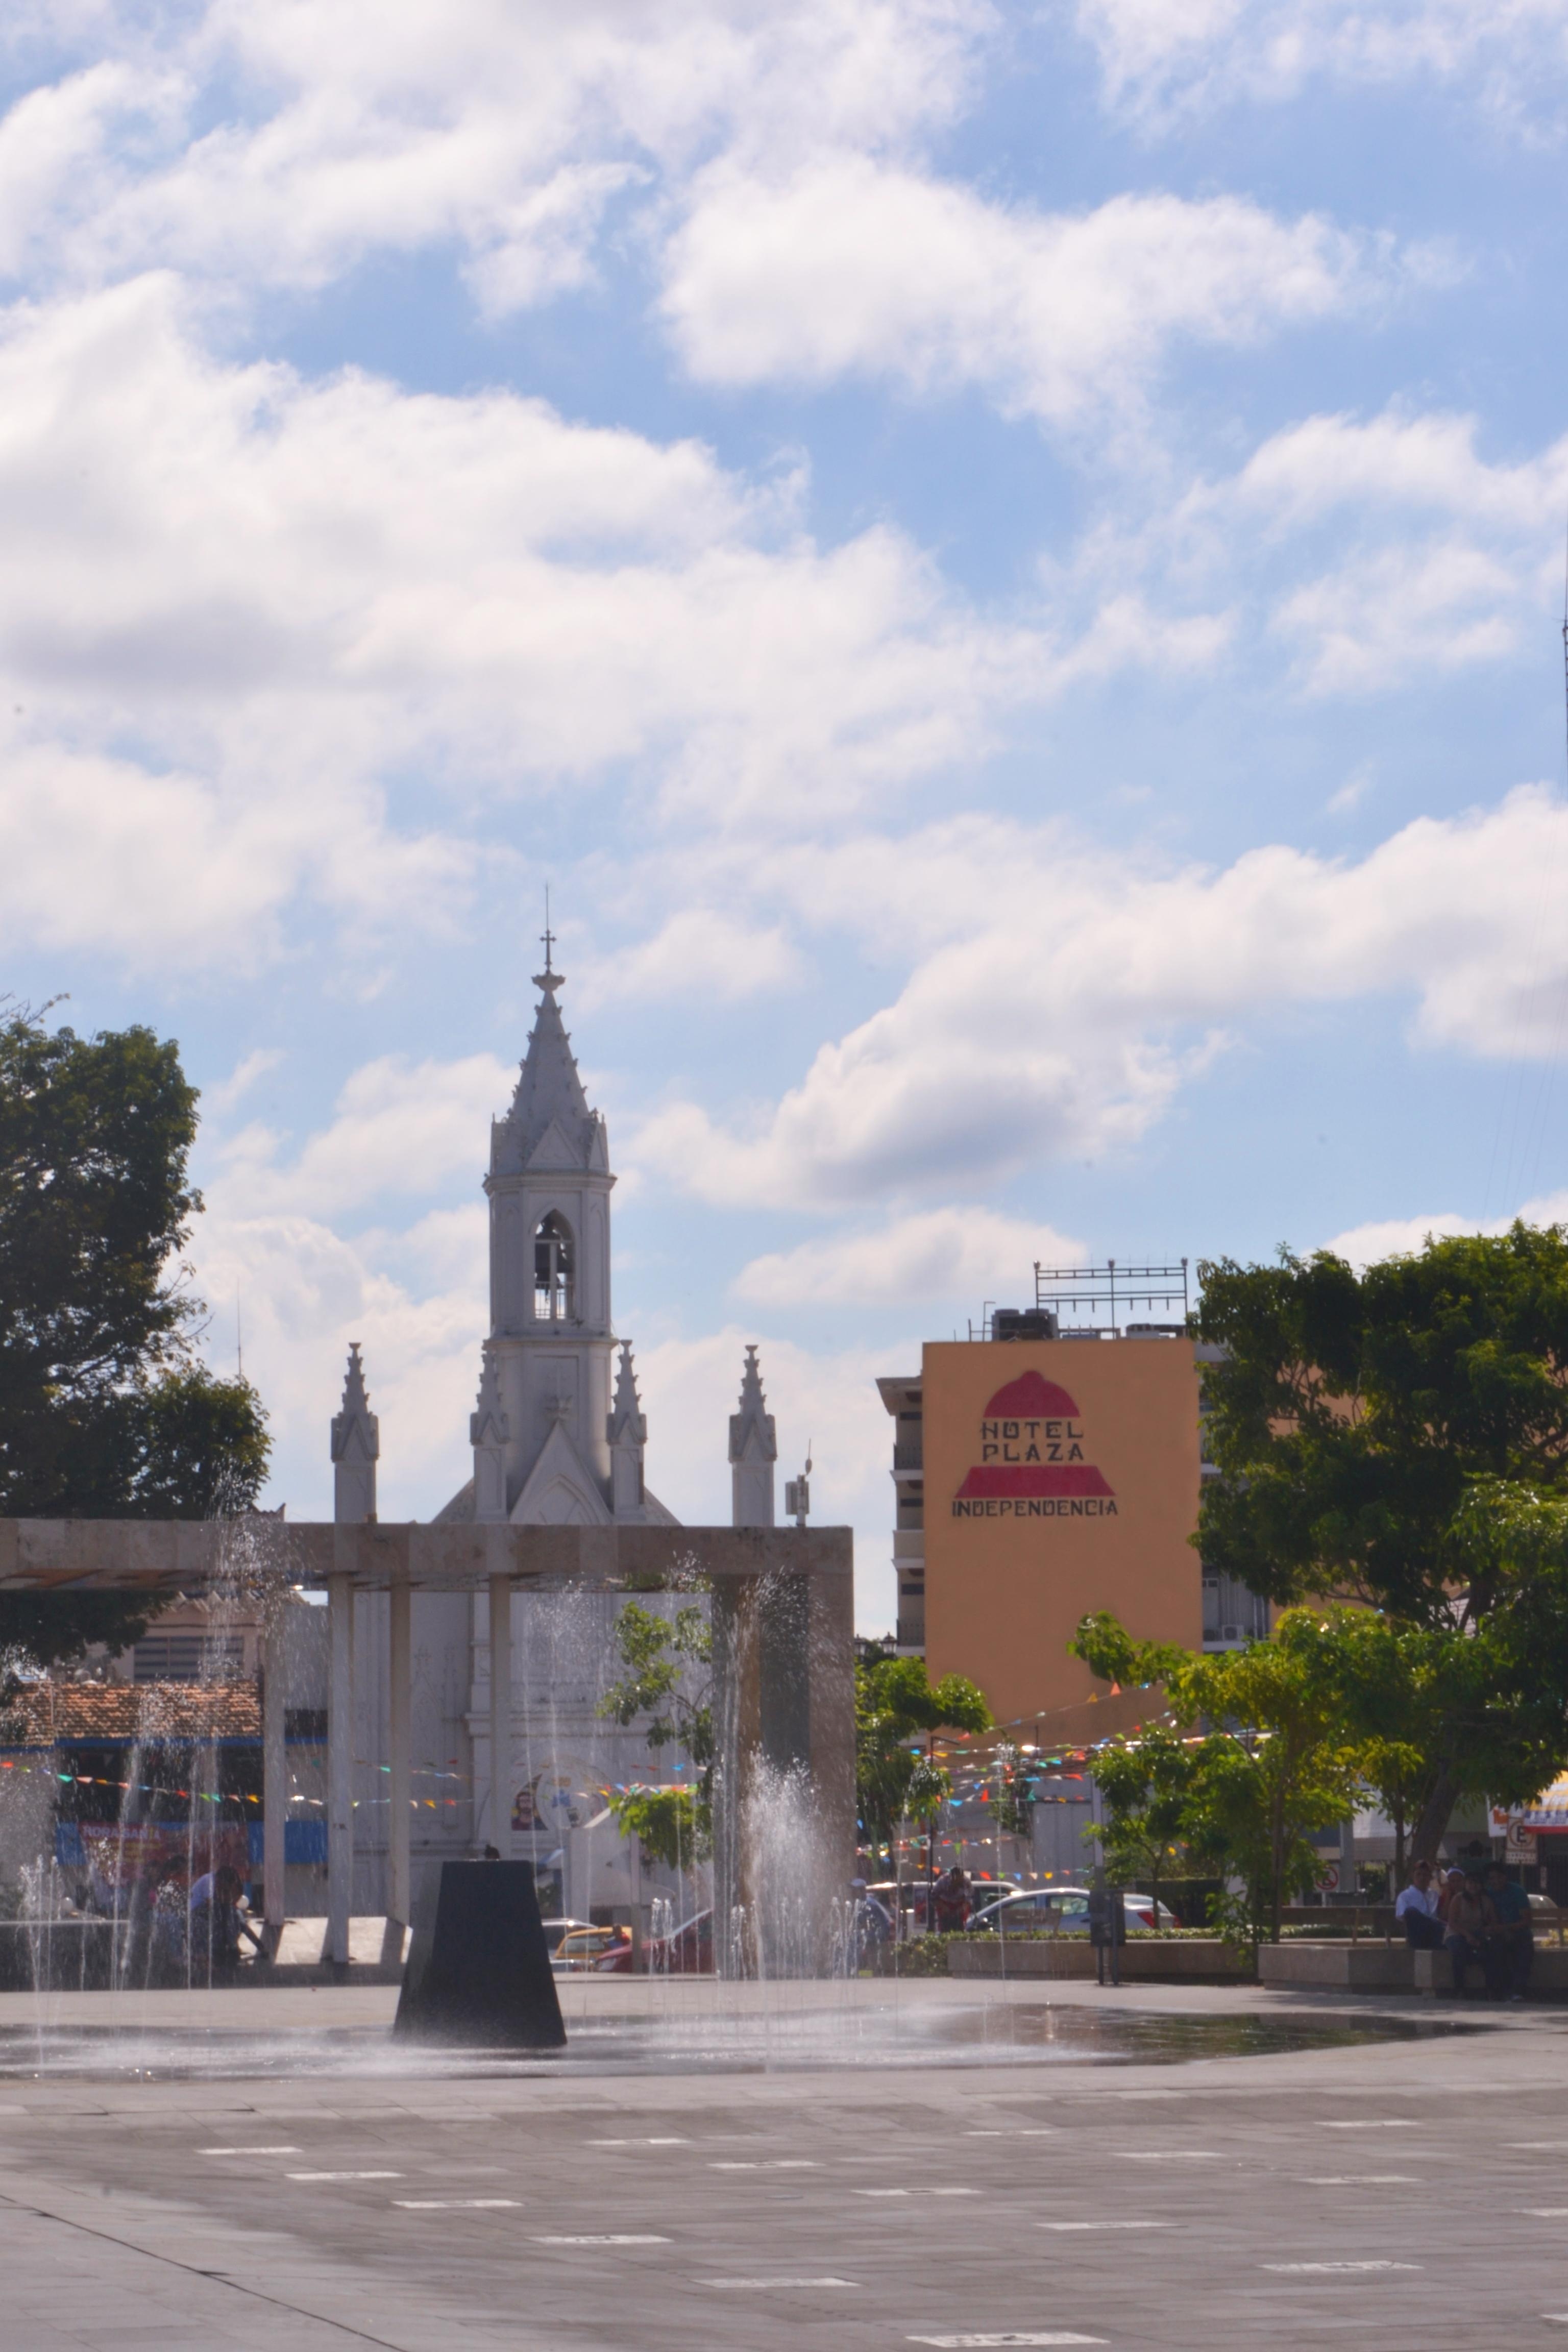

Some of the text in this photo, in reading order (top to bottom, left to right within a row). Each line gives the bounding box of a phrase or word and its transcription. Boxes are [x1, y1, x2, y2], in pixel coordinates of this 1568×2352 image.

[982, 1422, 1084, 1439] HOTEL
[983, 1443, 1084, 1461] PLAZA
[952, 1500, 1118, 1516] INDEPENDENCIA
[1517, 1826, 1527, 1843] E
